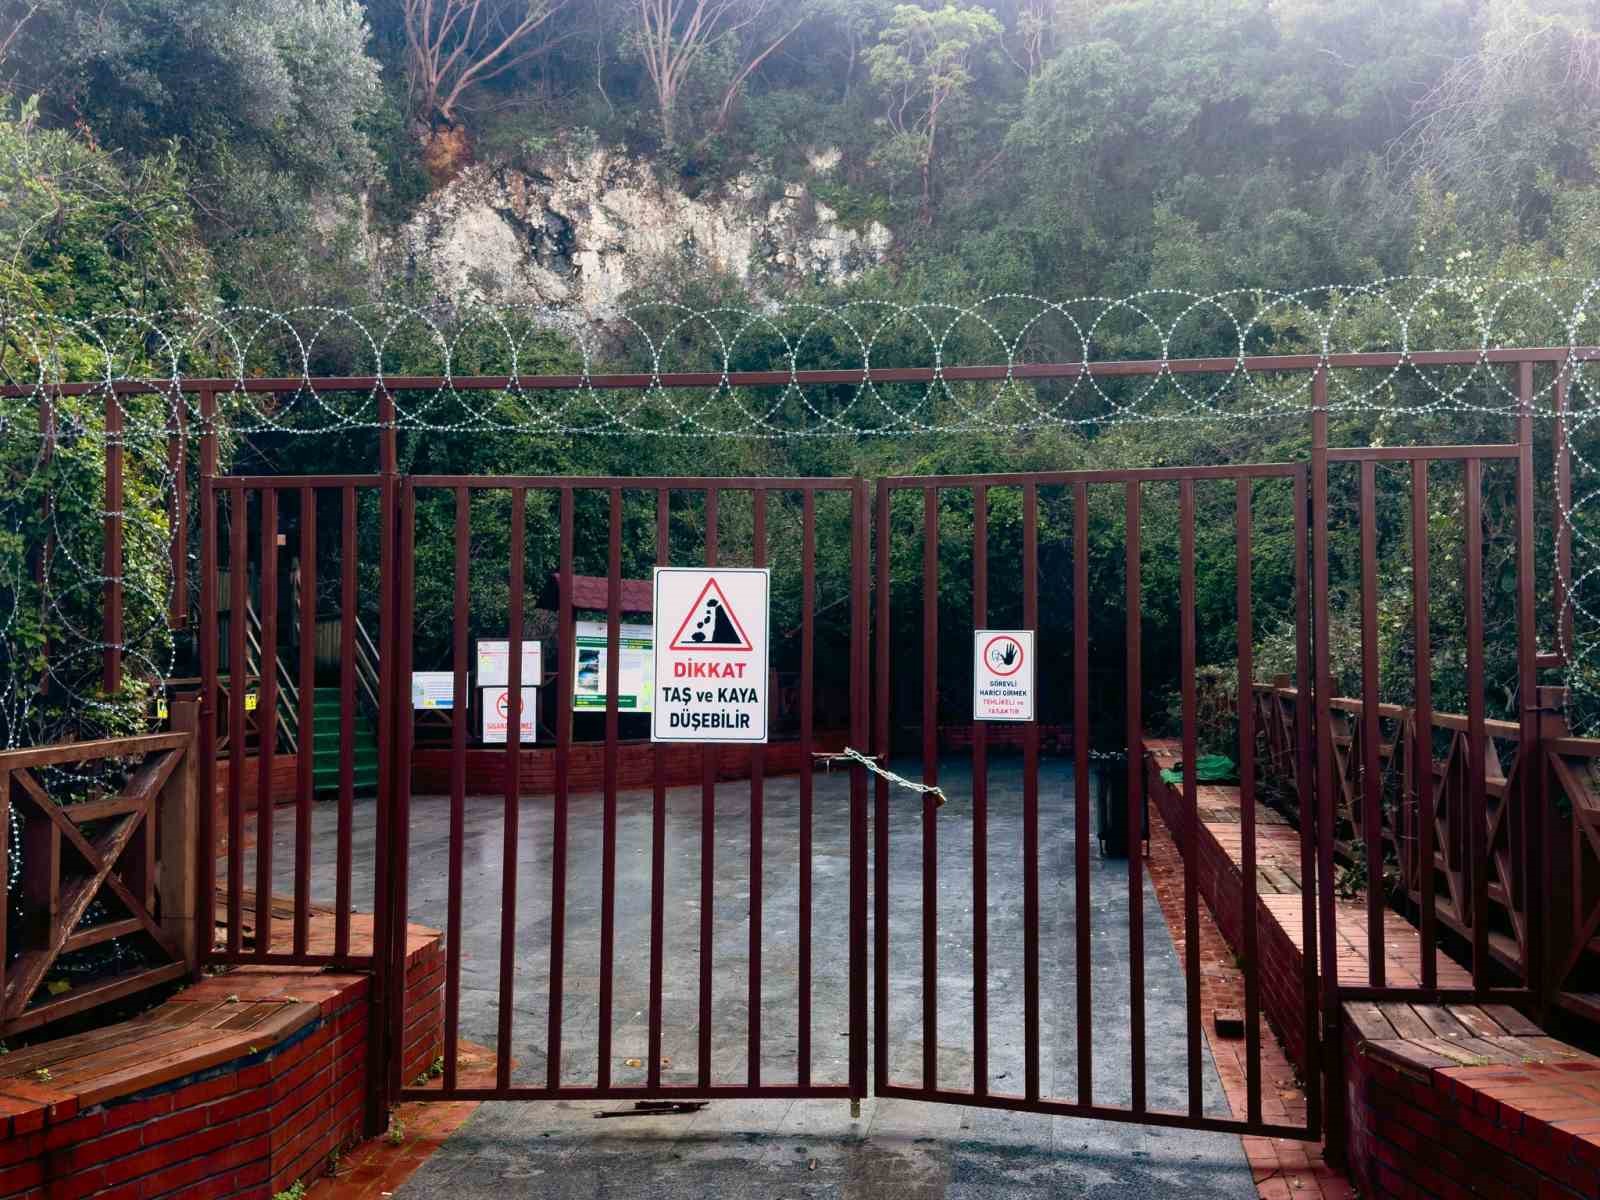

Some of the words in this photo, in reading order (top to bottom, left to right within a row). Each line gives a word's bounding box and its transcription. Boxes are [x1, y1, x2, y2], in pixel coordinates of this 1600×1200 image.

[673, 658, 747, 678] DİKKAT
[662, 687, 692, 706] TAŞ
[696, 691, 713, 702] ve
[718, 688, 758, 703] KAYA
[670, 708, 750, 731] DÜŞEBİLİR
